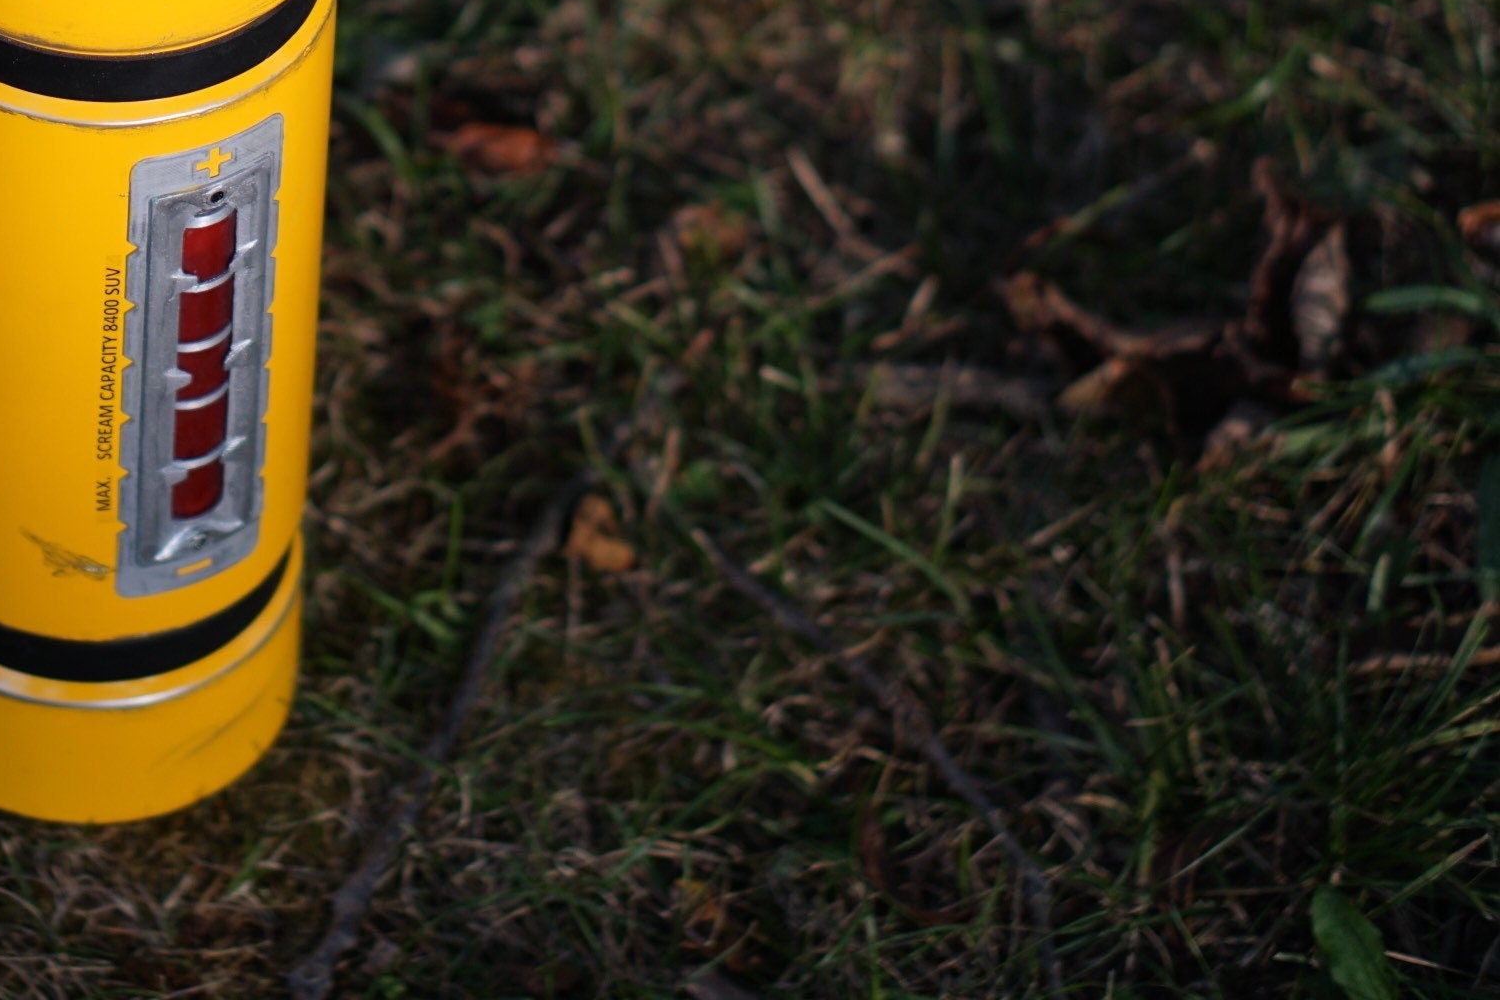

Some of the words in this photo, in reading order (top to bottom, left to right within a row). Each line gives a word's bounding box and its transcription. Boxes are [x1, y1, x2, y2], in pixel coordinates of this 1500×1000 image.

[104, 267, 120, 295] SUV
[103, 299, 119, 331] 8400
[100, 336, 117, 400] CAPACITY
[97, 405, 113, 460] SCREAM
[96, 477, 111, 511] MAX.
